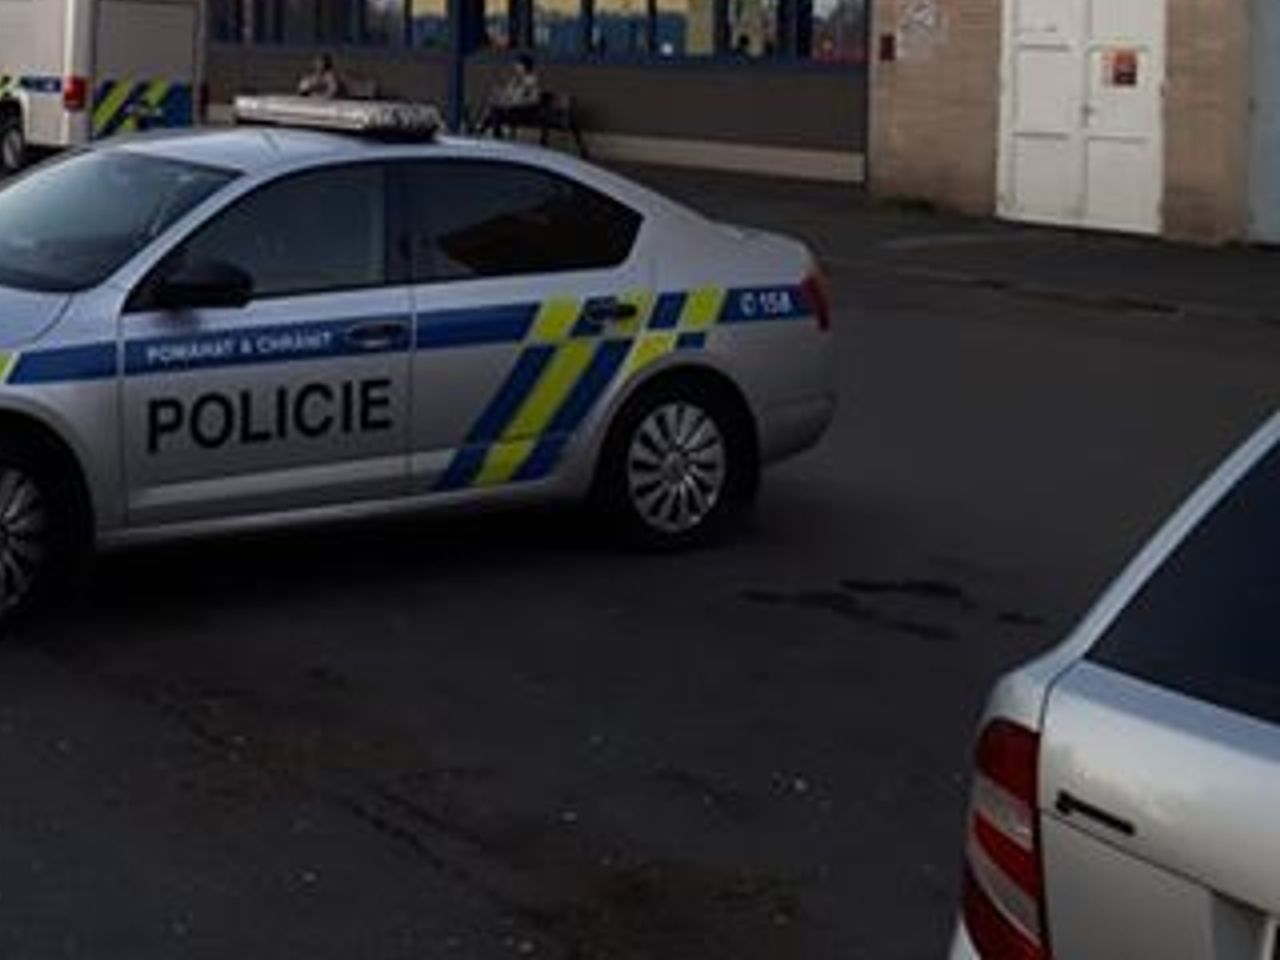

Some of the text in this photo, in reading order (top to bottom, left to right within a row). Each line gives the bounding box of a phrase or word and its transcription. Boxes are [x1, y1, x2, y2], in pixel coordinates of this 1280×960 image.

[740, 290, 793, 317] C 158
[146, 378, 395, 455] POLICIE
